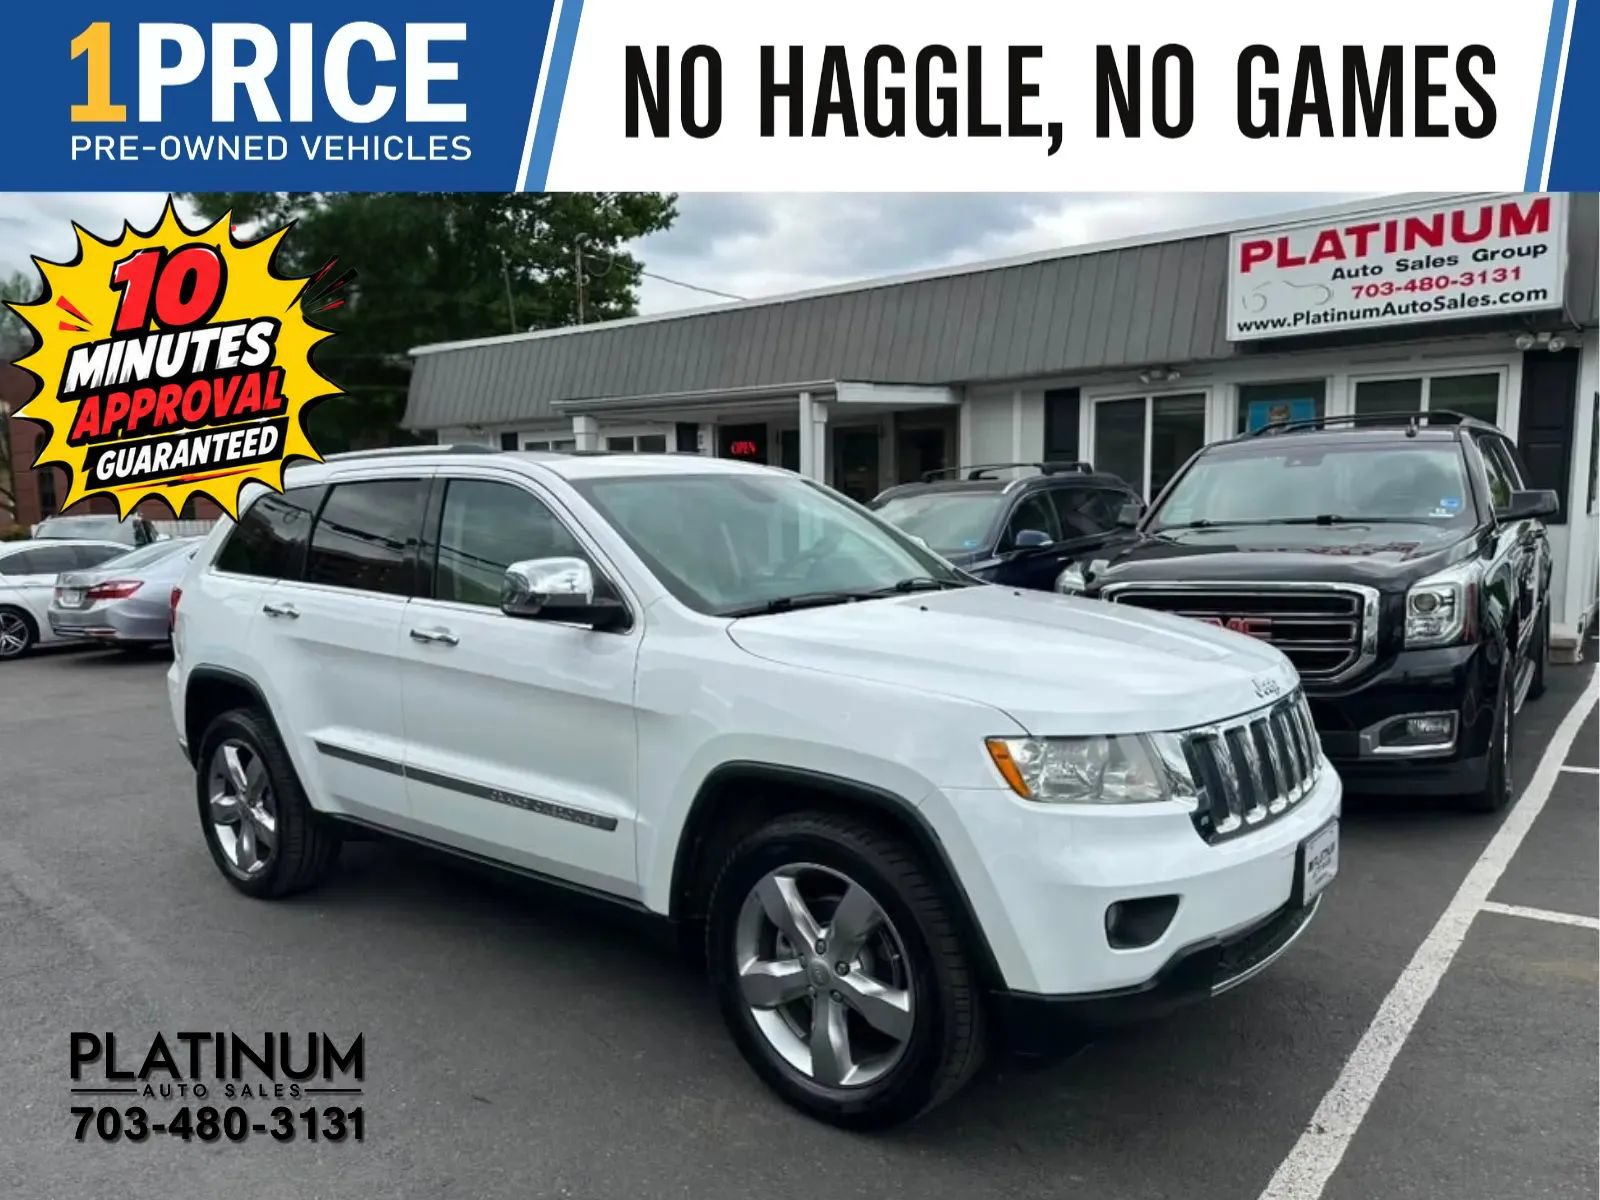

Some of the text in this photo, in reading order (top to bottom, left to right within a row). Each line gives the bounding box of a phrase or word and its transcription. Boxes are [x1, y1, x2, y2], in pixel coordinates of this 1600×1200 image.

[1240, 197, 1551, 274] PLATINUM
[1331, 242, 1548, 282] Auto Sales Group
[1351, 266, 1523, 300] 703-480-3131
[1237, 287, 1548, 333] www.PlatinumAutoSales.com
